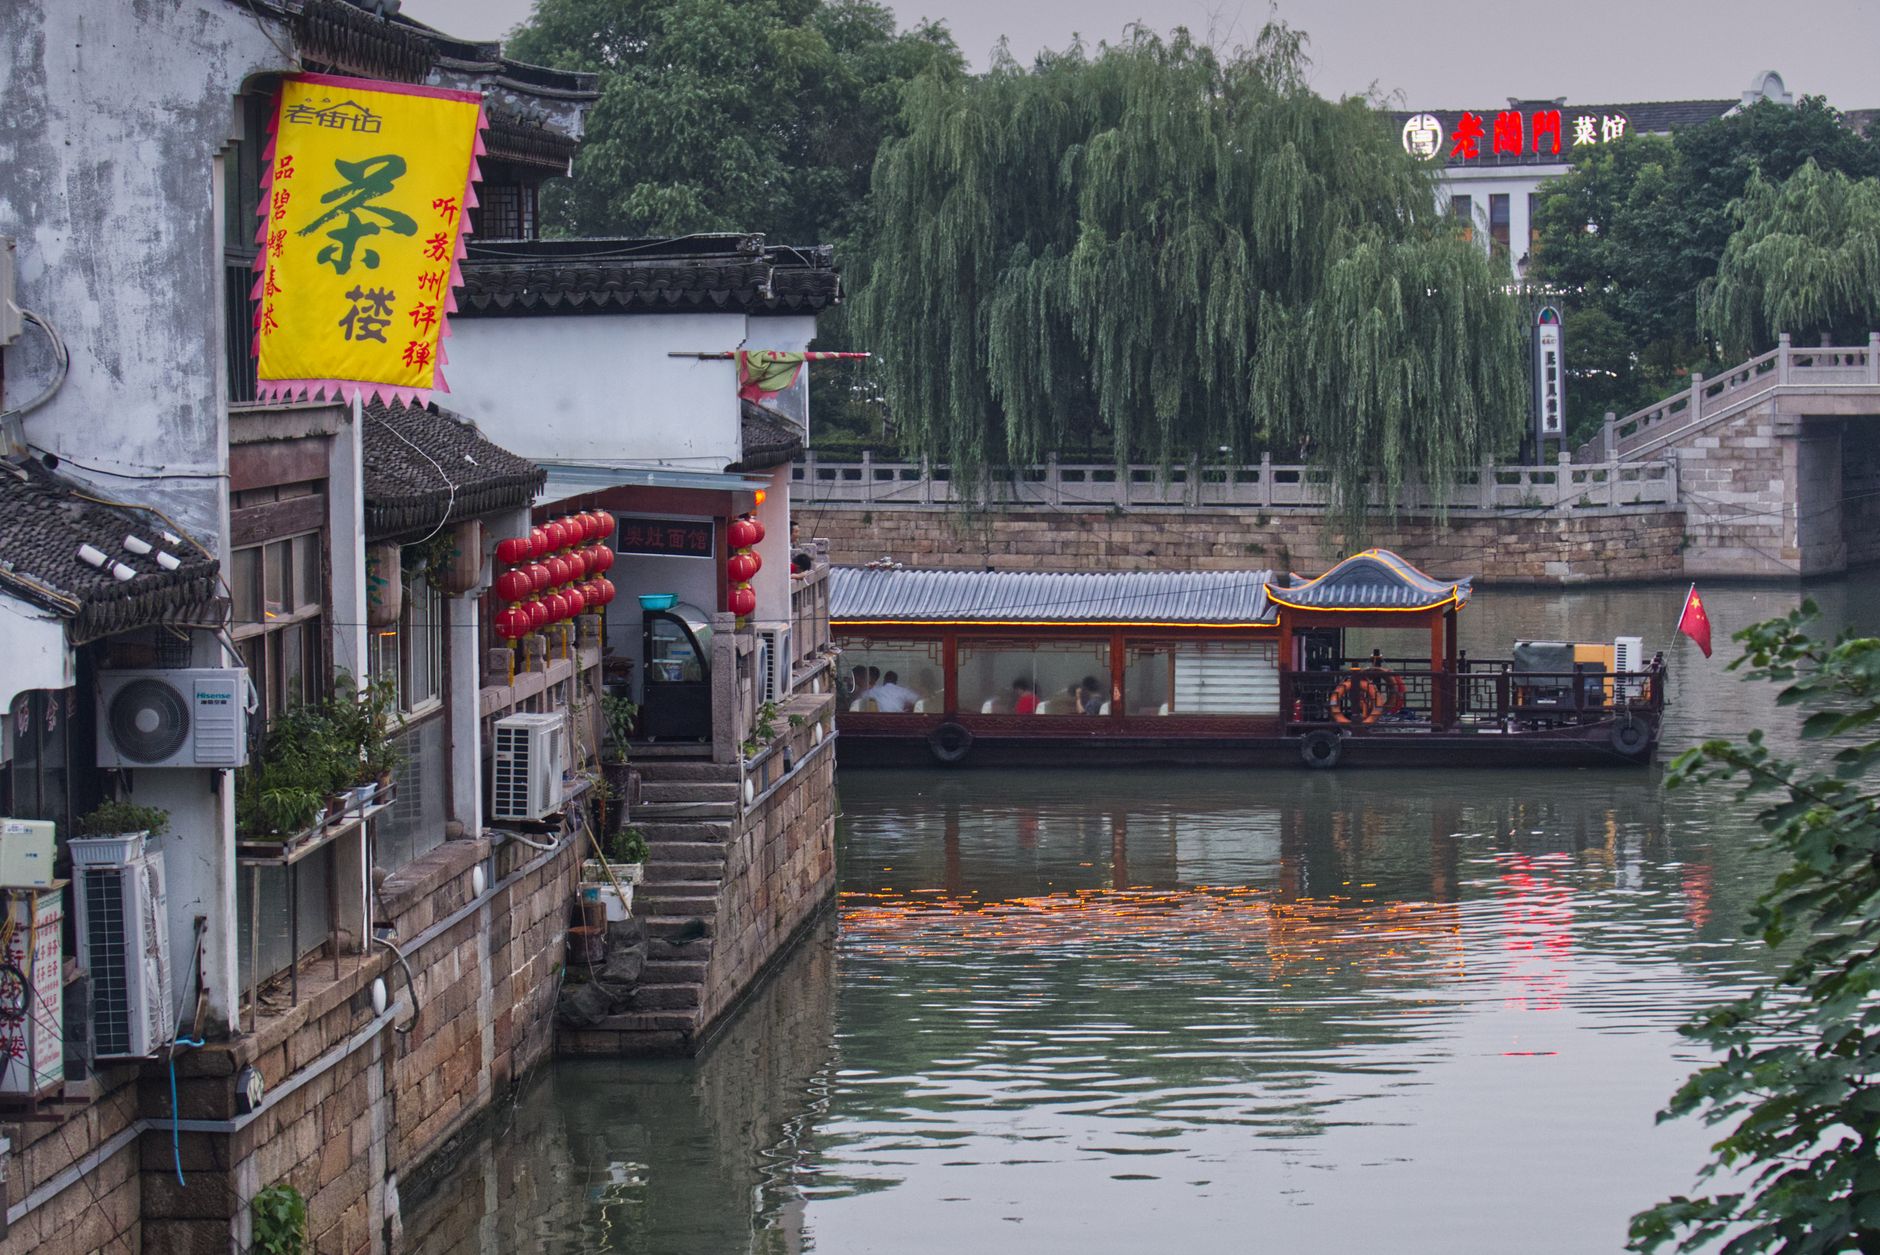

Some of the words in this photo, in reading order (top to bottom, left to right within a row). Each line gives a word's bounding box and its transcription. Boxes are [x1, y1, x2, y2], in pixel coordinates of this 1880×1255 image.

[284, 100, 383, 133] 老街坊
[262, 155, 294, 335] 品碧螺春茶
[296, 154, 418, 343] 茶楼
[402, 196, 458, 373] 听苏州评弹
